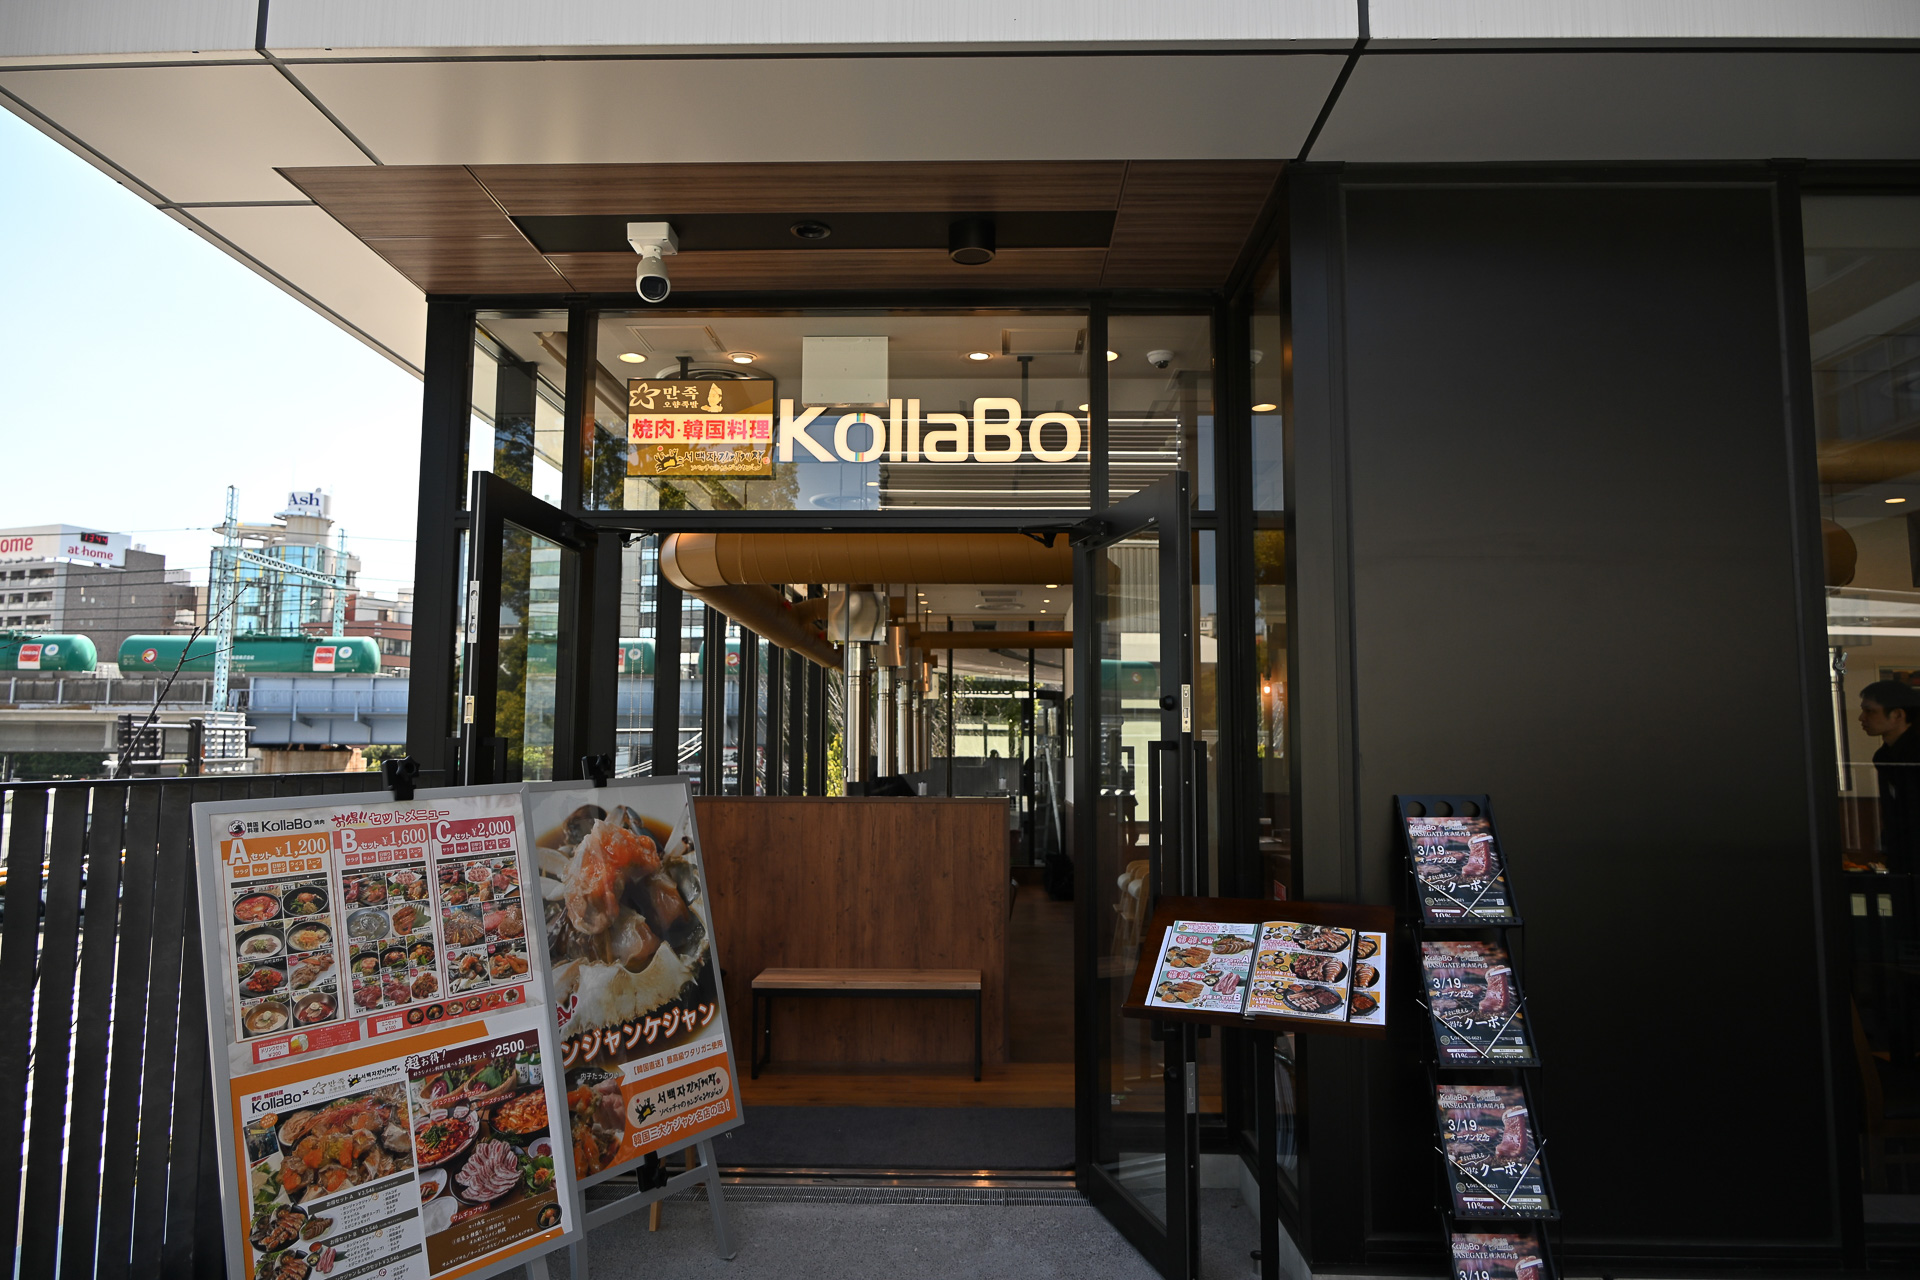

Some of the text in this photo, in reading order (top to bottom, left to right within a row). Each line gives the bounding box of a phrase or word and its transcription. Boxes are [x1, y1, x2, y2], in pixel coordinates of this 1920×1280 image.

[662, 386, 699, 400] 만족
[632, 418, 770, 440] 焼肉・韓国料理
[780, 397, 1082, 462] KollaBo
[288, 493, 320, 506] Ash
[68, 546, 114, 560] at home
[262, 818, 312, 833] KollaBo
[436, 820, 451, 843] C
[472, 820, 511, 837] ¥2,000
[341, 829, 358, 853] B
[382, 828, 426, 847] ¥1,600
[229, 839, 250, 864] A
[275, 838, 326, 858] ¥1,200
[1417, 845, 1445, 856] 3/19
[1433, 977, 1461, 989] 3/19
[252, 1093, 301, 1113] KollaBo
[1448, 1118, 1477, 1131] 3/19
[1460, 1270, 1490, 1280] 3/19
